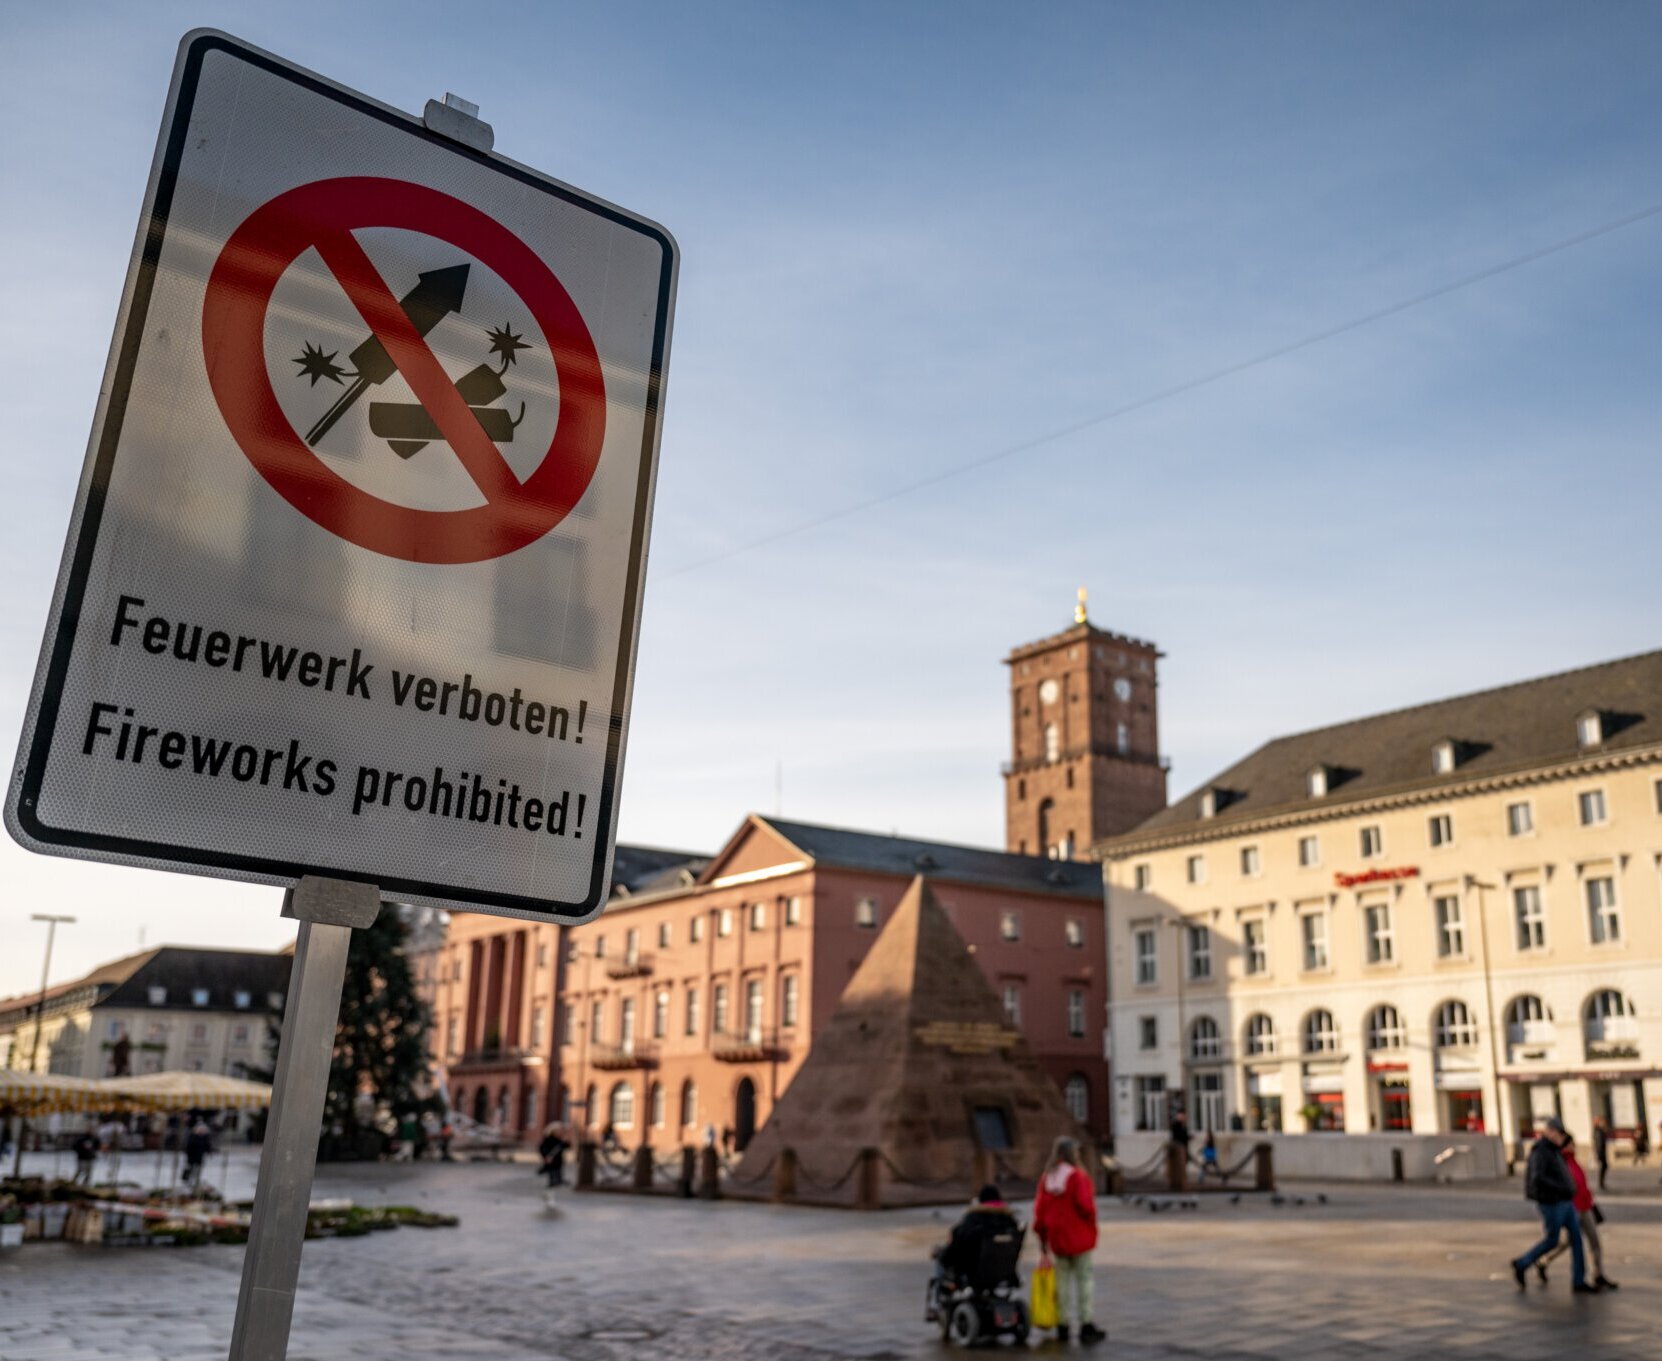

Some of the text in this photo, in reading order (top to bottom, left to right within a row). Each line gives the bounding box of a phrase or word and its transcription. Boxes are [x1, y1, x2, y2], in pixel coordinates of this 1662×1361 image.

[110, 595, 588, 744] Feuerwerk verboten!
[82, 702, 587, 838] Fireworks prohibited!
